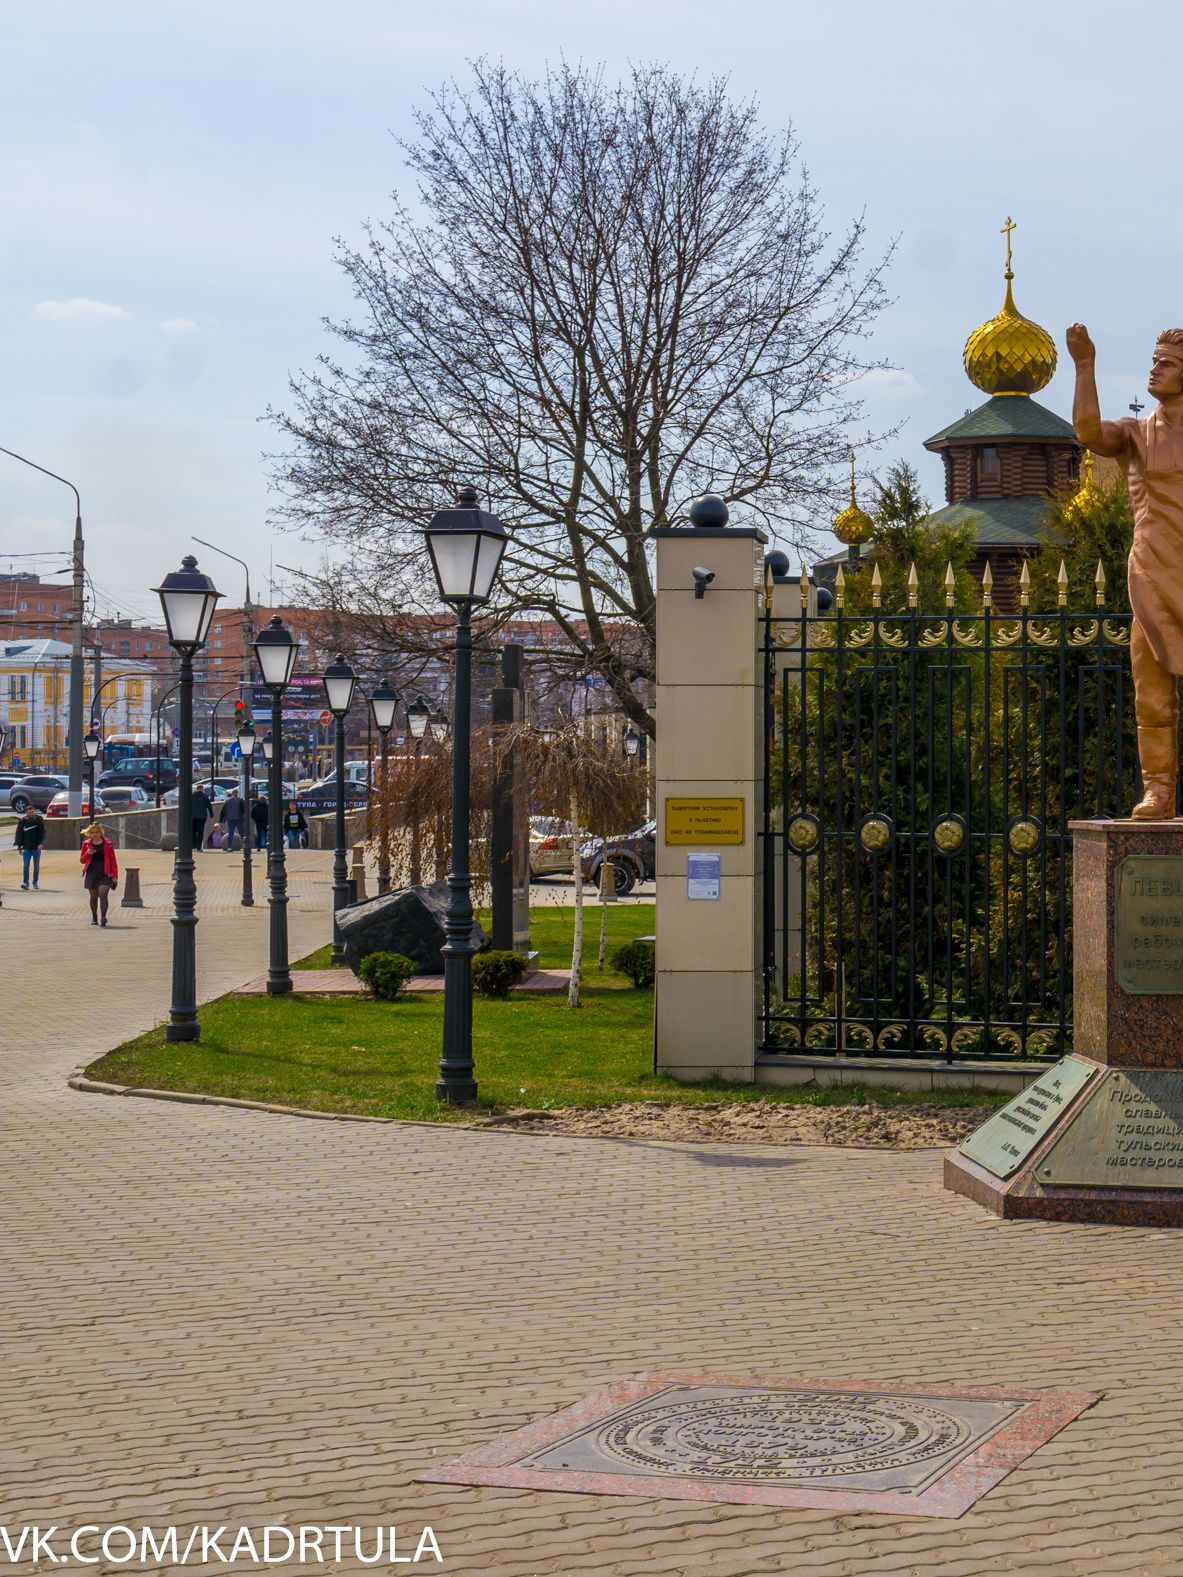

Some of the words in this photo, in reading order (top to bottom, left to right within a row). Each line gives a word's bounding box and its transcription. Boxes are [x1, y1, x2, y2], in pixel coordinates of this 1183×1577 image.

[757, 1415, 847, 1427] 1939
[717, 1438, 808, 1451] 1879
[689, 1455, 783, 1467] 1712
